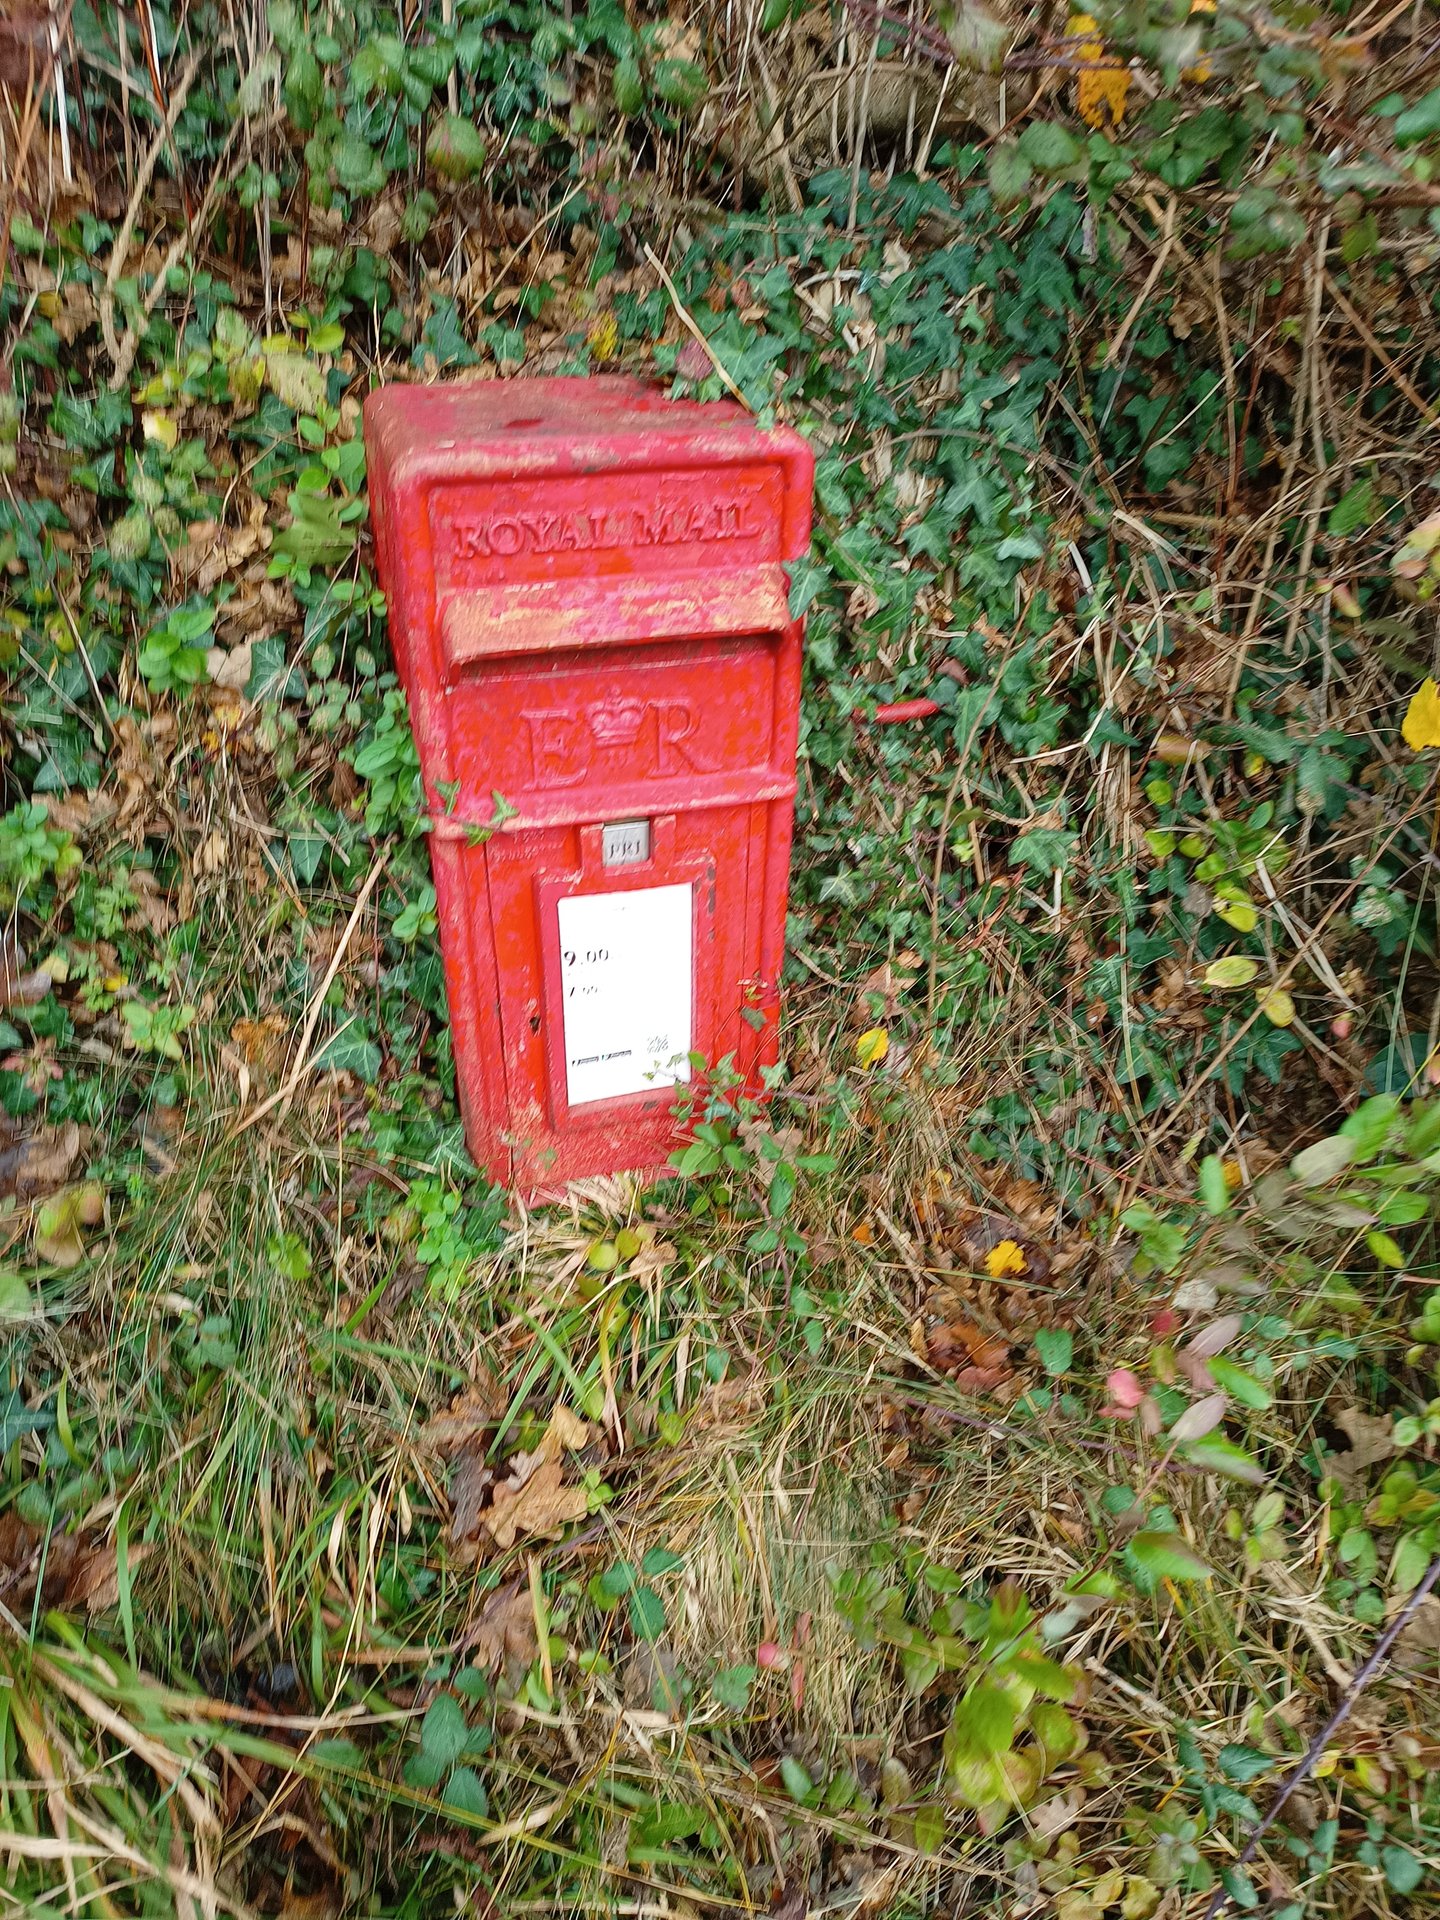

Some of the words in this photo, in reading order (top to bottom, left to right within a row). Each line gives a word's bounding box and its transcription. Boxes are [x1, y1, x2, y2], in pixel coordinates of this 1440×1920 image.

[454, 511, 618, 557] ROYAL
[633, 500, 763, 545] MAIL
[519, 708, 588, 792] E
[648, 698, 723, 779] R
[563, 948, 609, 967] 9.00
